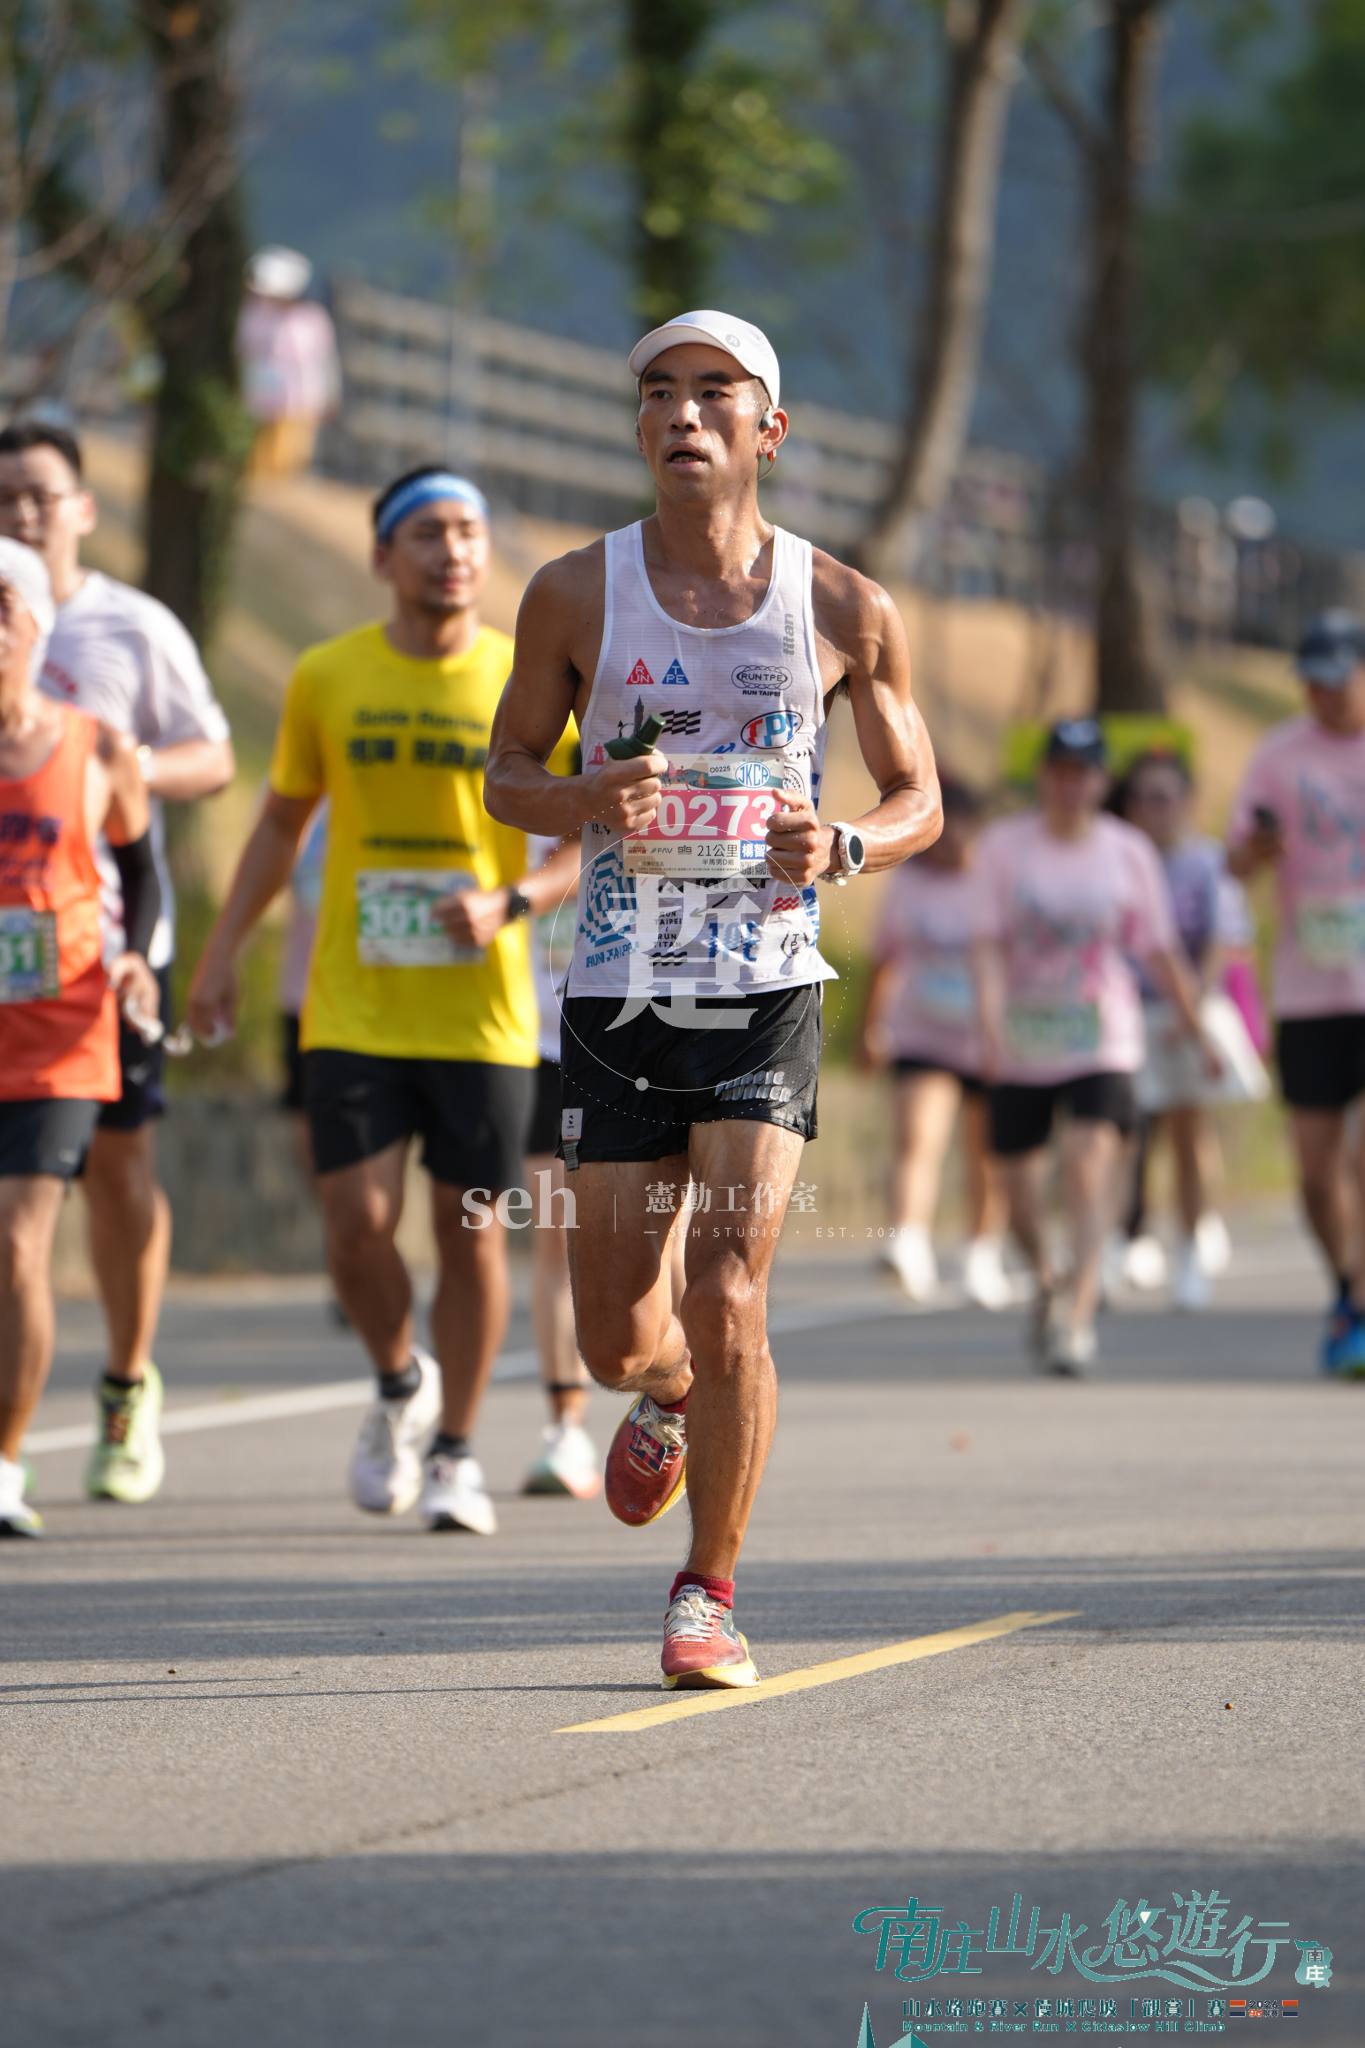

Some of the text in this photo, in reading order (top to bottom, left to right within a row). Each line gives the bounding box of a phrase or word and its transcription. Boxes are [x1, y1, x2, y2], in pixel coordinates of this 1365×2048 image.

[783, 613, 795, 656] titan
[742, 689, 781, 698] RUN TAIPEI
[638, 795, 777, 837] 0273
[697, 844, 738, 858] 21公里
